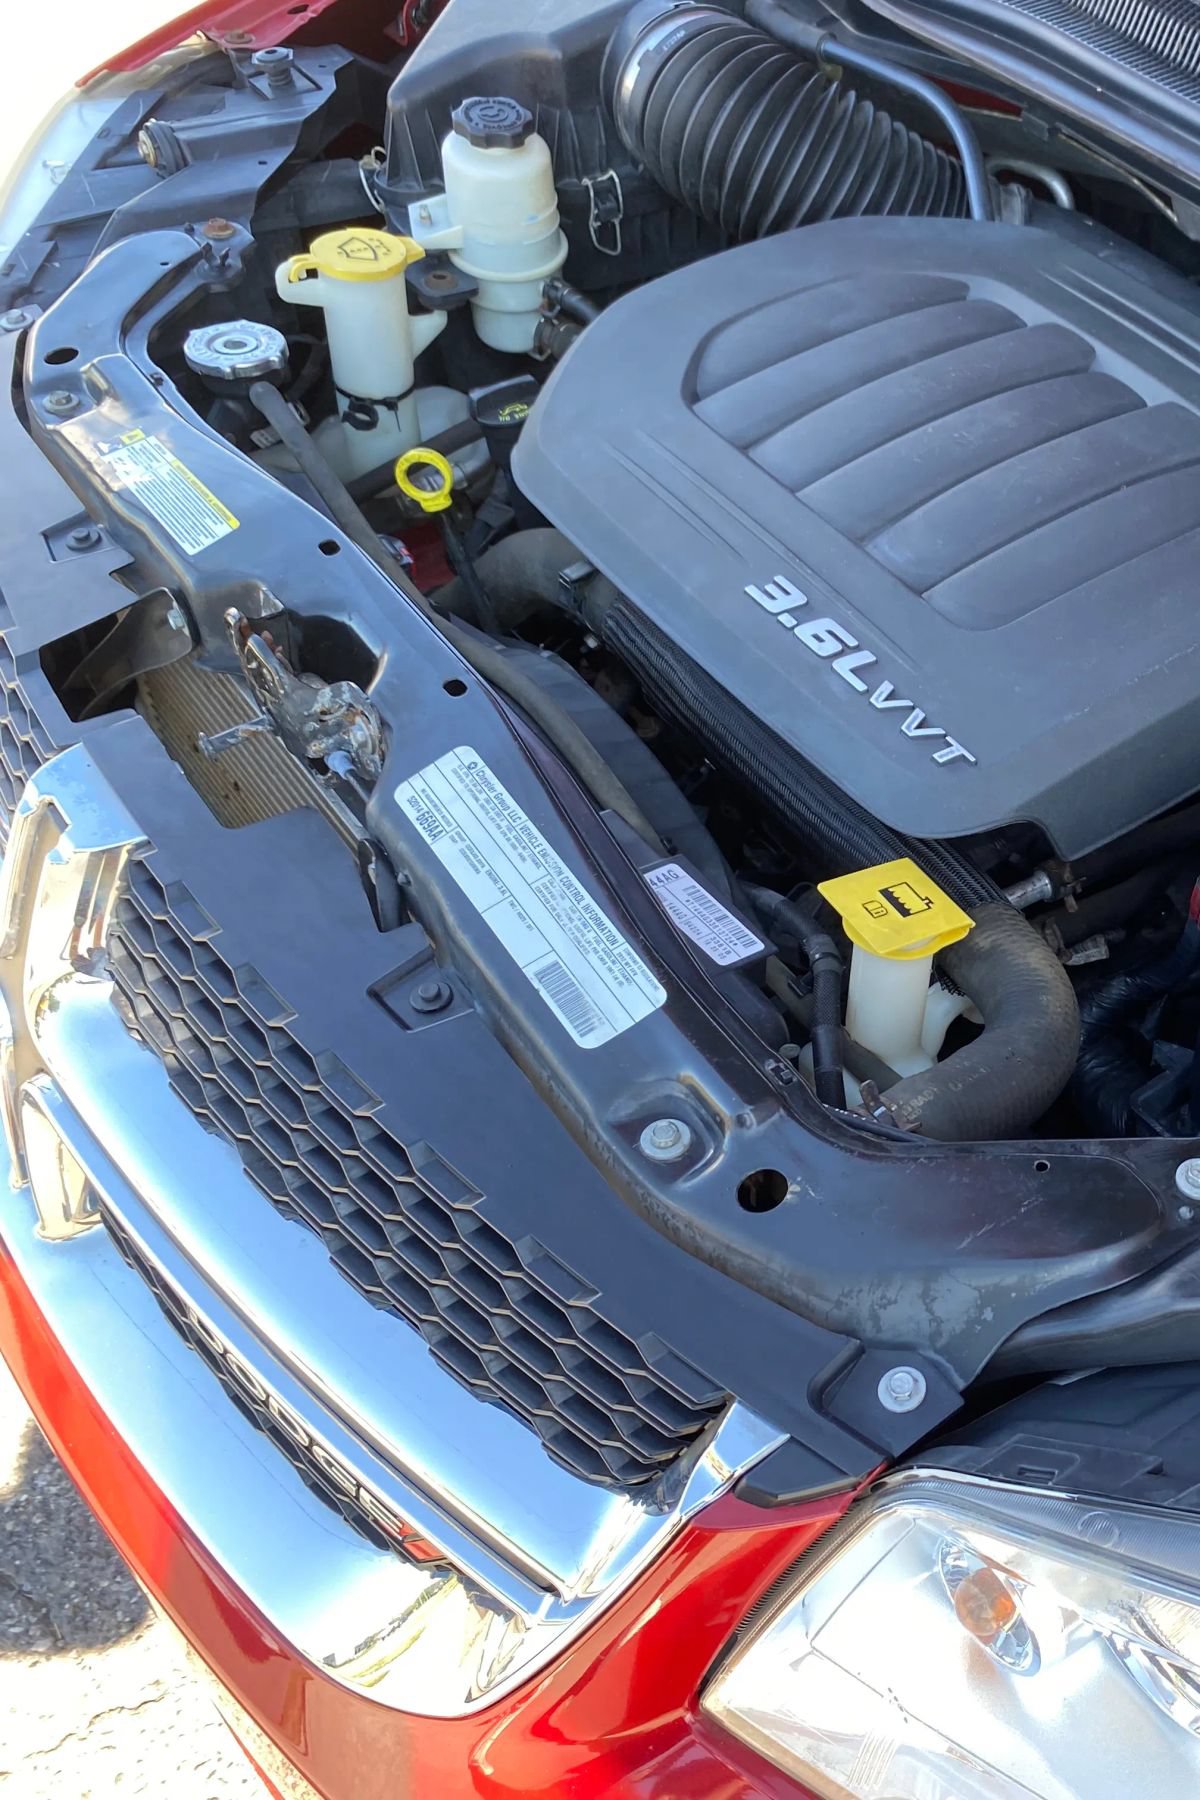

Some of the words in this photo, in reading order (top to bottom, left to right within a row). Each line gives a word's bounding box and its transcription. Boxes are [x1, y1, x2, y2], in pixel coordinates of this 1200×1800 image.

[473, 768, 499, 795] Chrysler
[492, 791, 512, 812] Group
[506, 809, 522, 823] LLC
[518, 823, 543, 850] VEHICLE
[536, 846, 565, 878] EMISSION
[558, 874, 587, 905] CONTROL
[580, 901, 620, 947] INFORMATION
